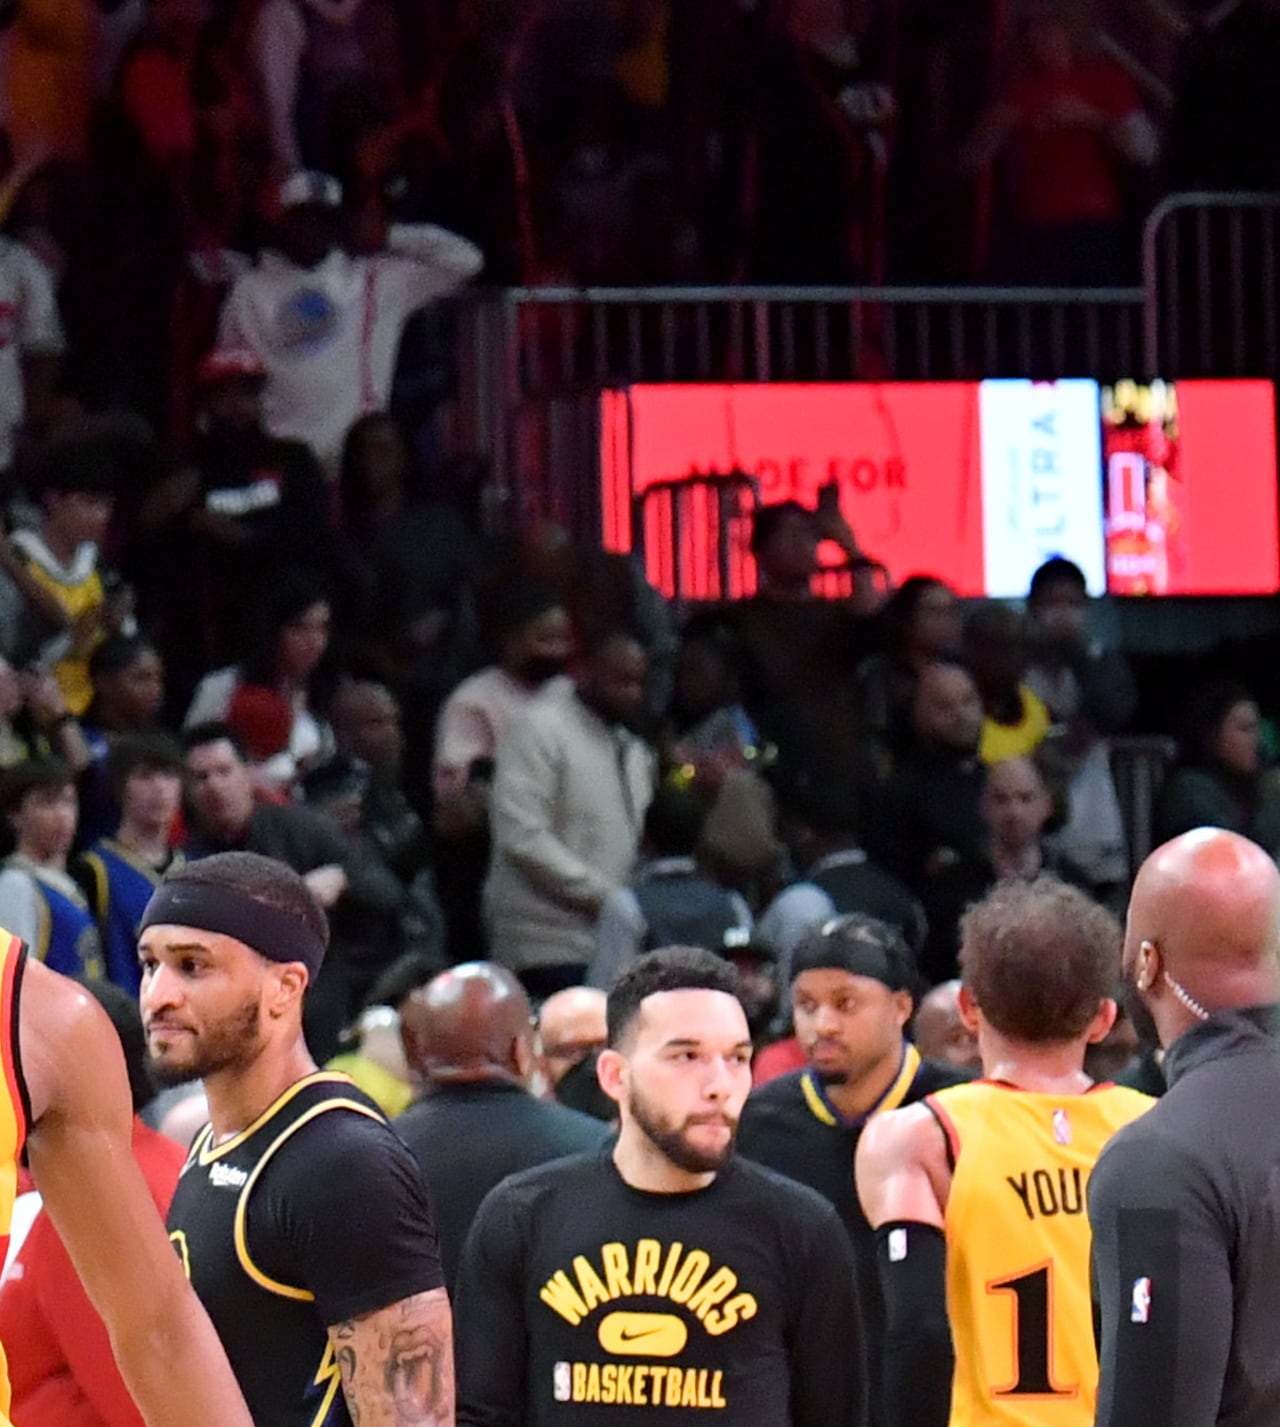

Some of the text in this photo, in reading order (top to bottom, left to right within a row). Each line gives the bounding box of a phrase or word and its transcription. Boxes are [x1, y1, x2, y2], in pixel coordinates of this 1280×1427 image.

[539, 1238, 758, 1337] WARRIORS
[985, 1256, 1080, 1401] 1
[572, 1362, 727, 1408] BASKETBALL
